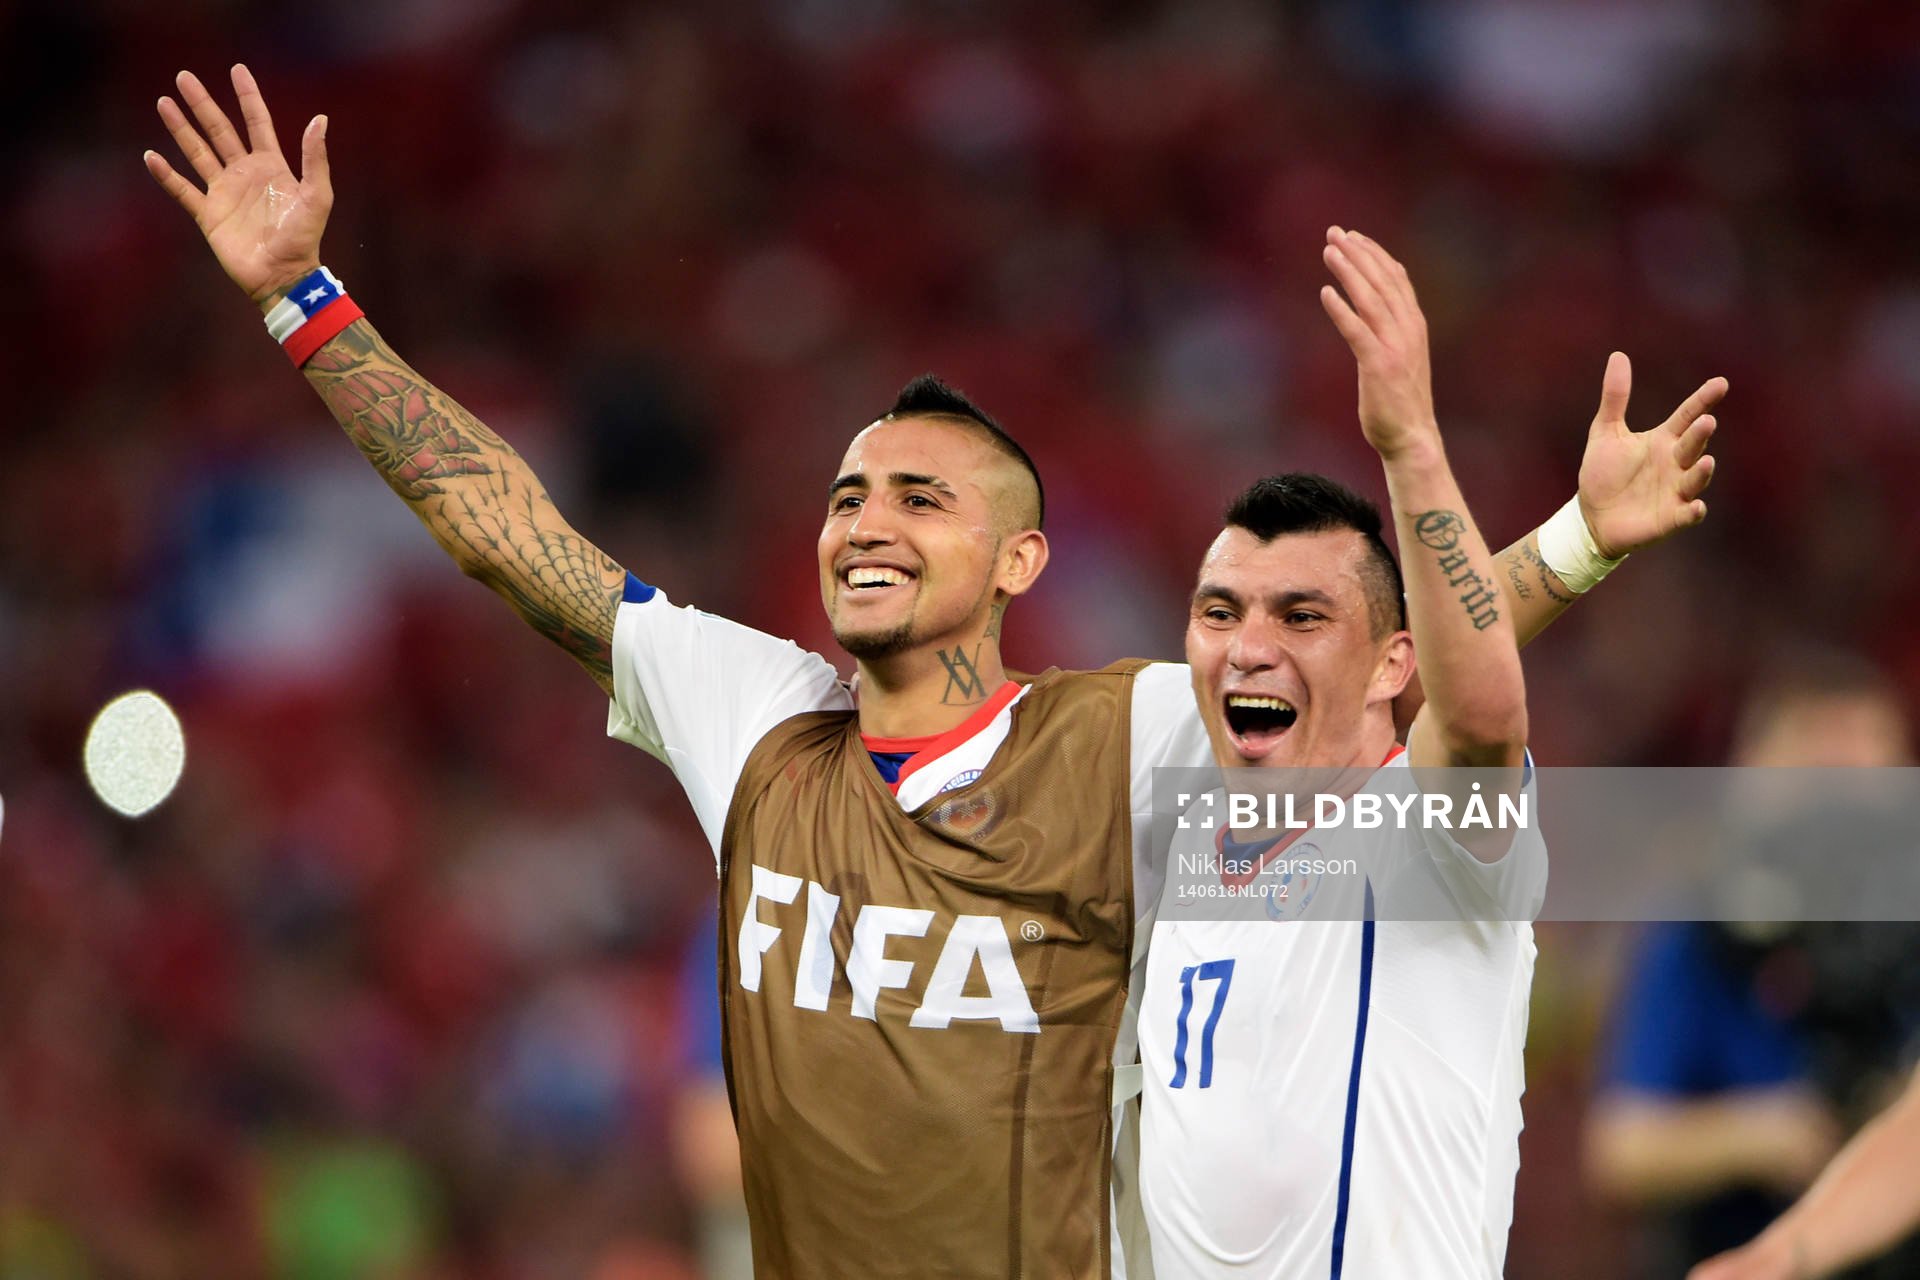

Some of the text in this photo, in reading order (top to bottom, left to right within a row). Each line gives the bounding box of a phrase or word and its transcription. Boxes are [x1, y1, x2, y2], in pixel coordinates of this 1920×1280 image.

[1408, 510, 1498, 630] Garito
[738, 864, 1041, 1034] FIFA
[1169, 958, 1236, 1089] 17
